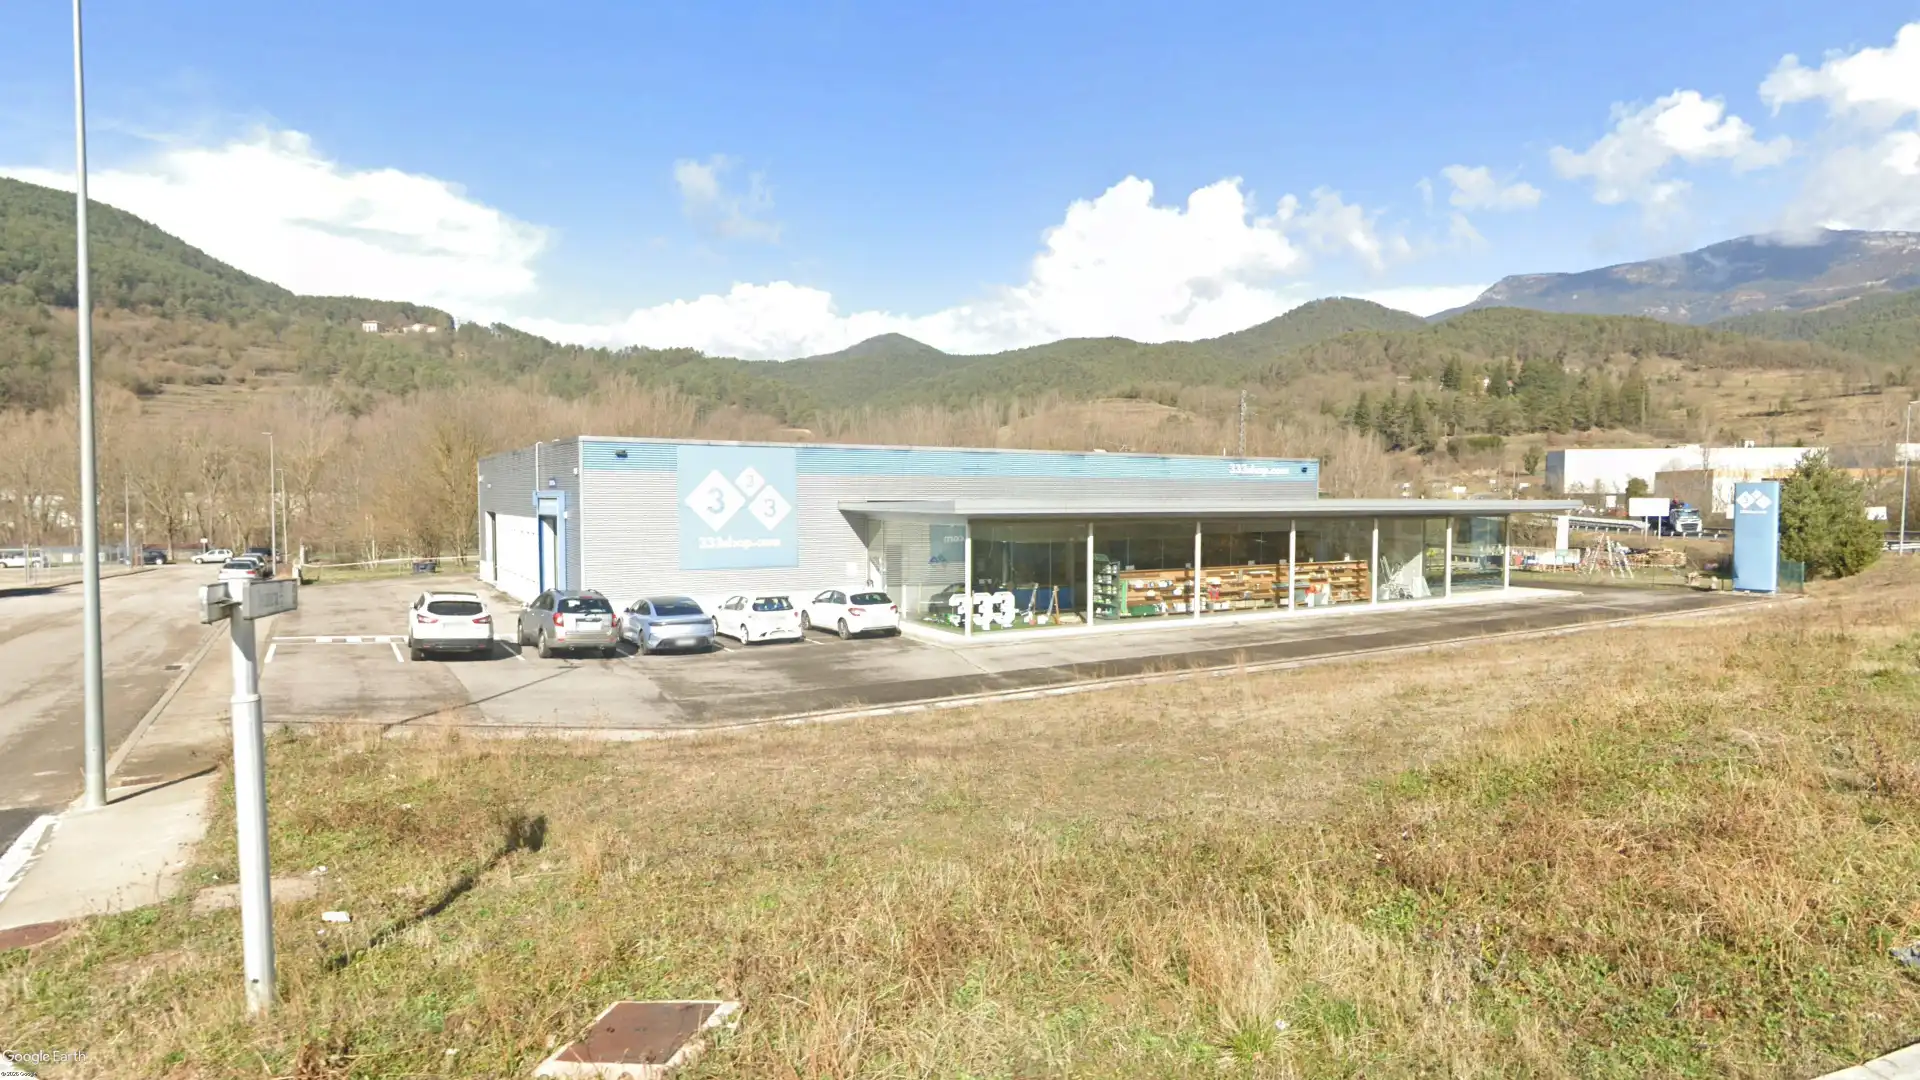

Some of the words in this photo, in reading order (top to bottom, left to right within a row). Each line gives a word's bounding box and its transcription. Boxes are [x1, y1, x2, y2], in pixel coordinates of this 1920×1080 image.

[746, 474, 755, 488] 3
[706, 486, 726, 515] 3
[763, 498, 777, 518] 3
